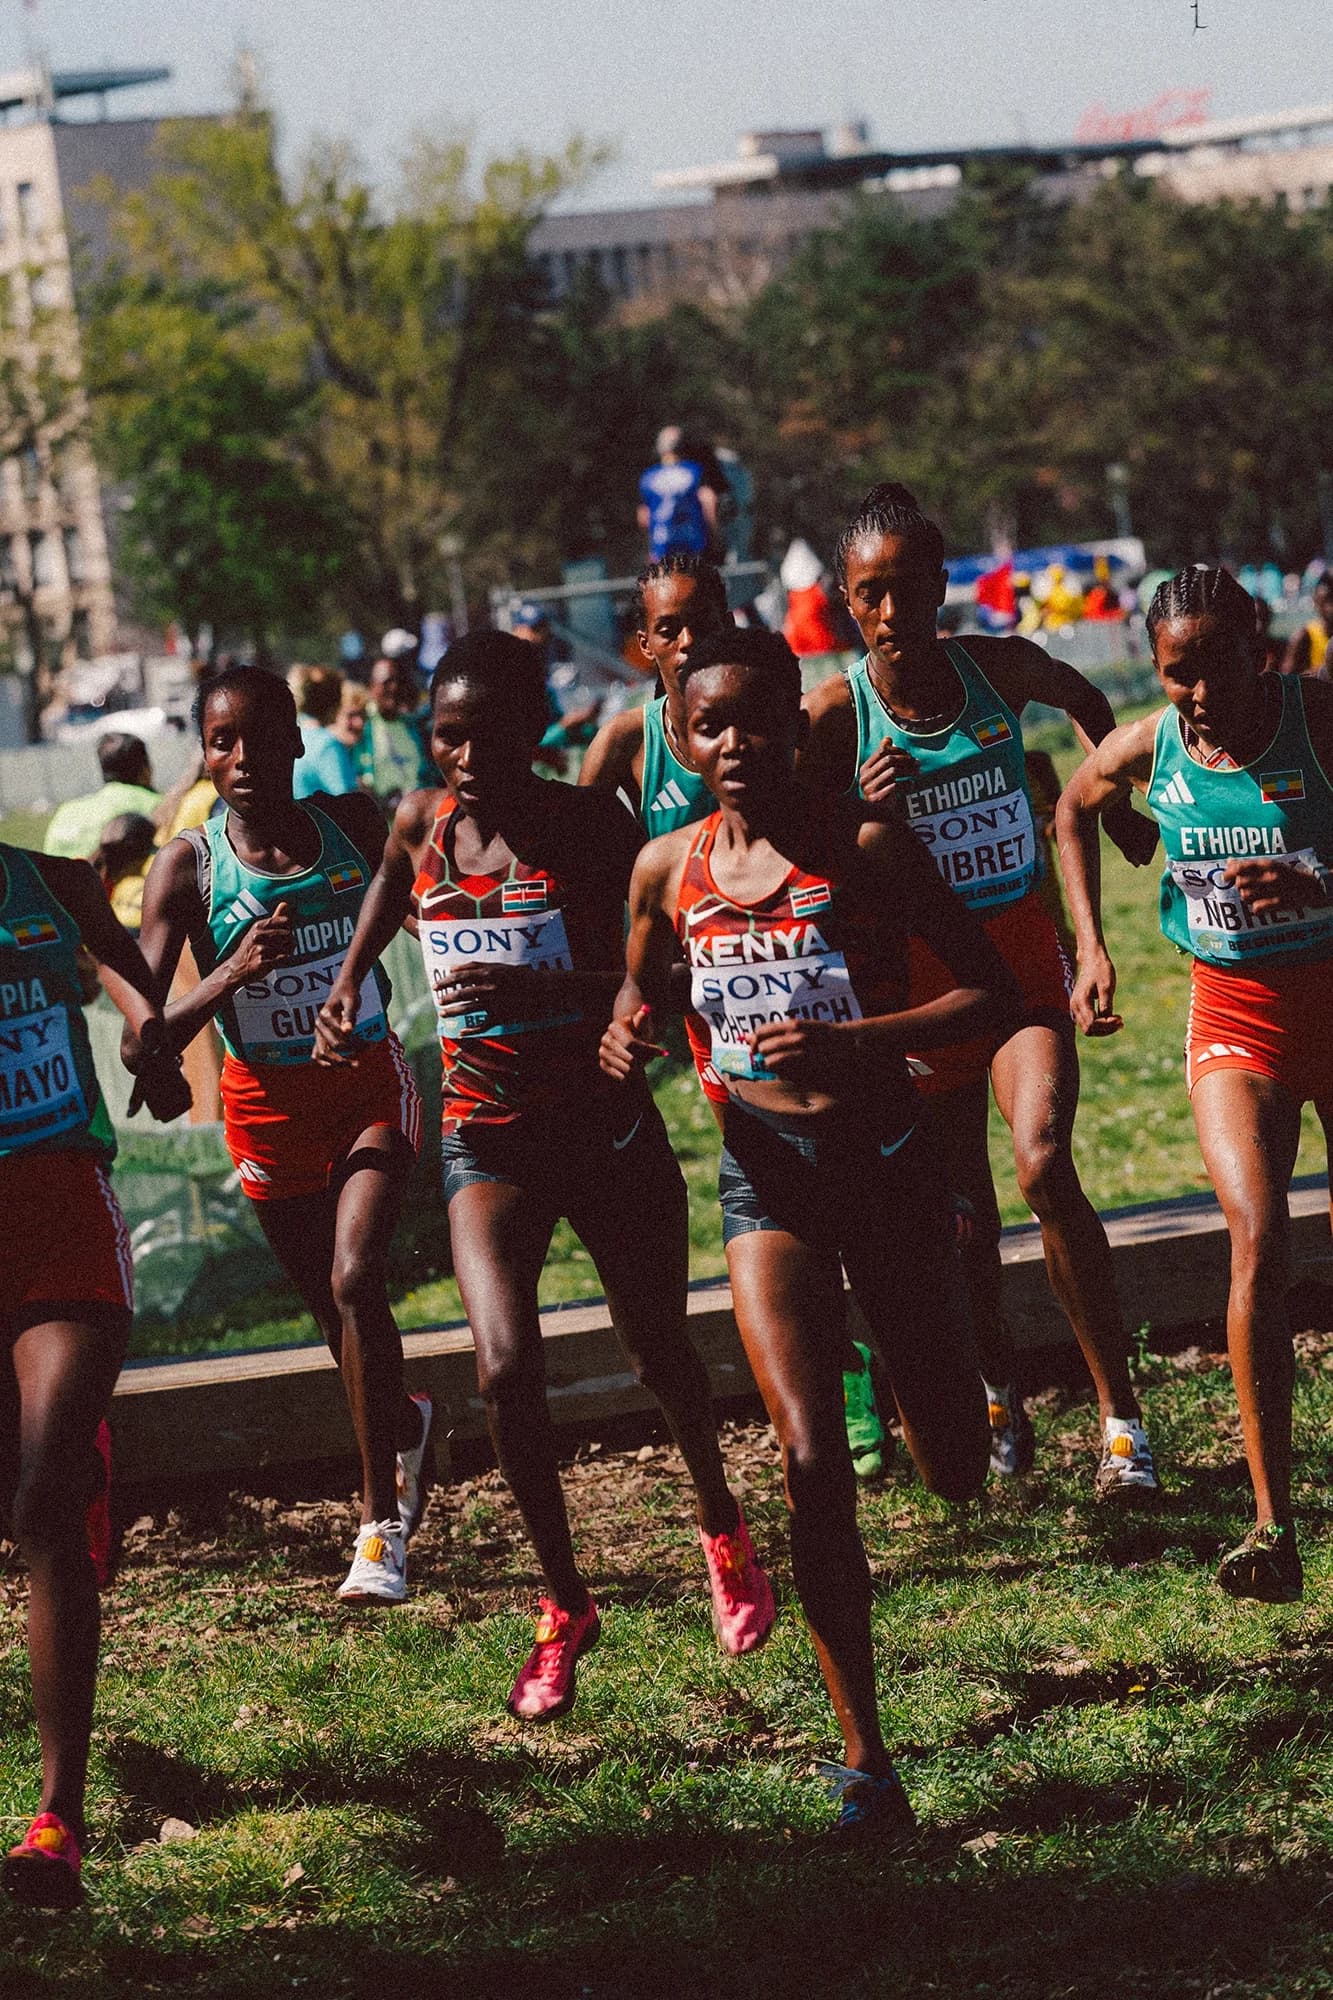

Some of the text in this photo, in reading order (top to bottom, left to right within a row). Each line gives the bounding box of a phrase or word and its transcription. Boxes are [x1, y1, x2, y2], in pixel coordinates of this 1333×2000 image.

[906, 766, 1007, 818] ETHIOPIA
[912, 799, 1020, 845] SONY
[1180, 826, 1287, 856] ETHIOPIA
[941, 832, 1026, 883] IBRET
[292, 916, 355, 956] IOPIA
[429, 922, 547, 955] SONY
[690, 924, 830, 968] KENYA
[245, 962, 345, 1000] SON
[702, 964, 829, 1002] SONY
[271, 1001, 326, 1039] GU
